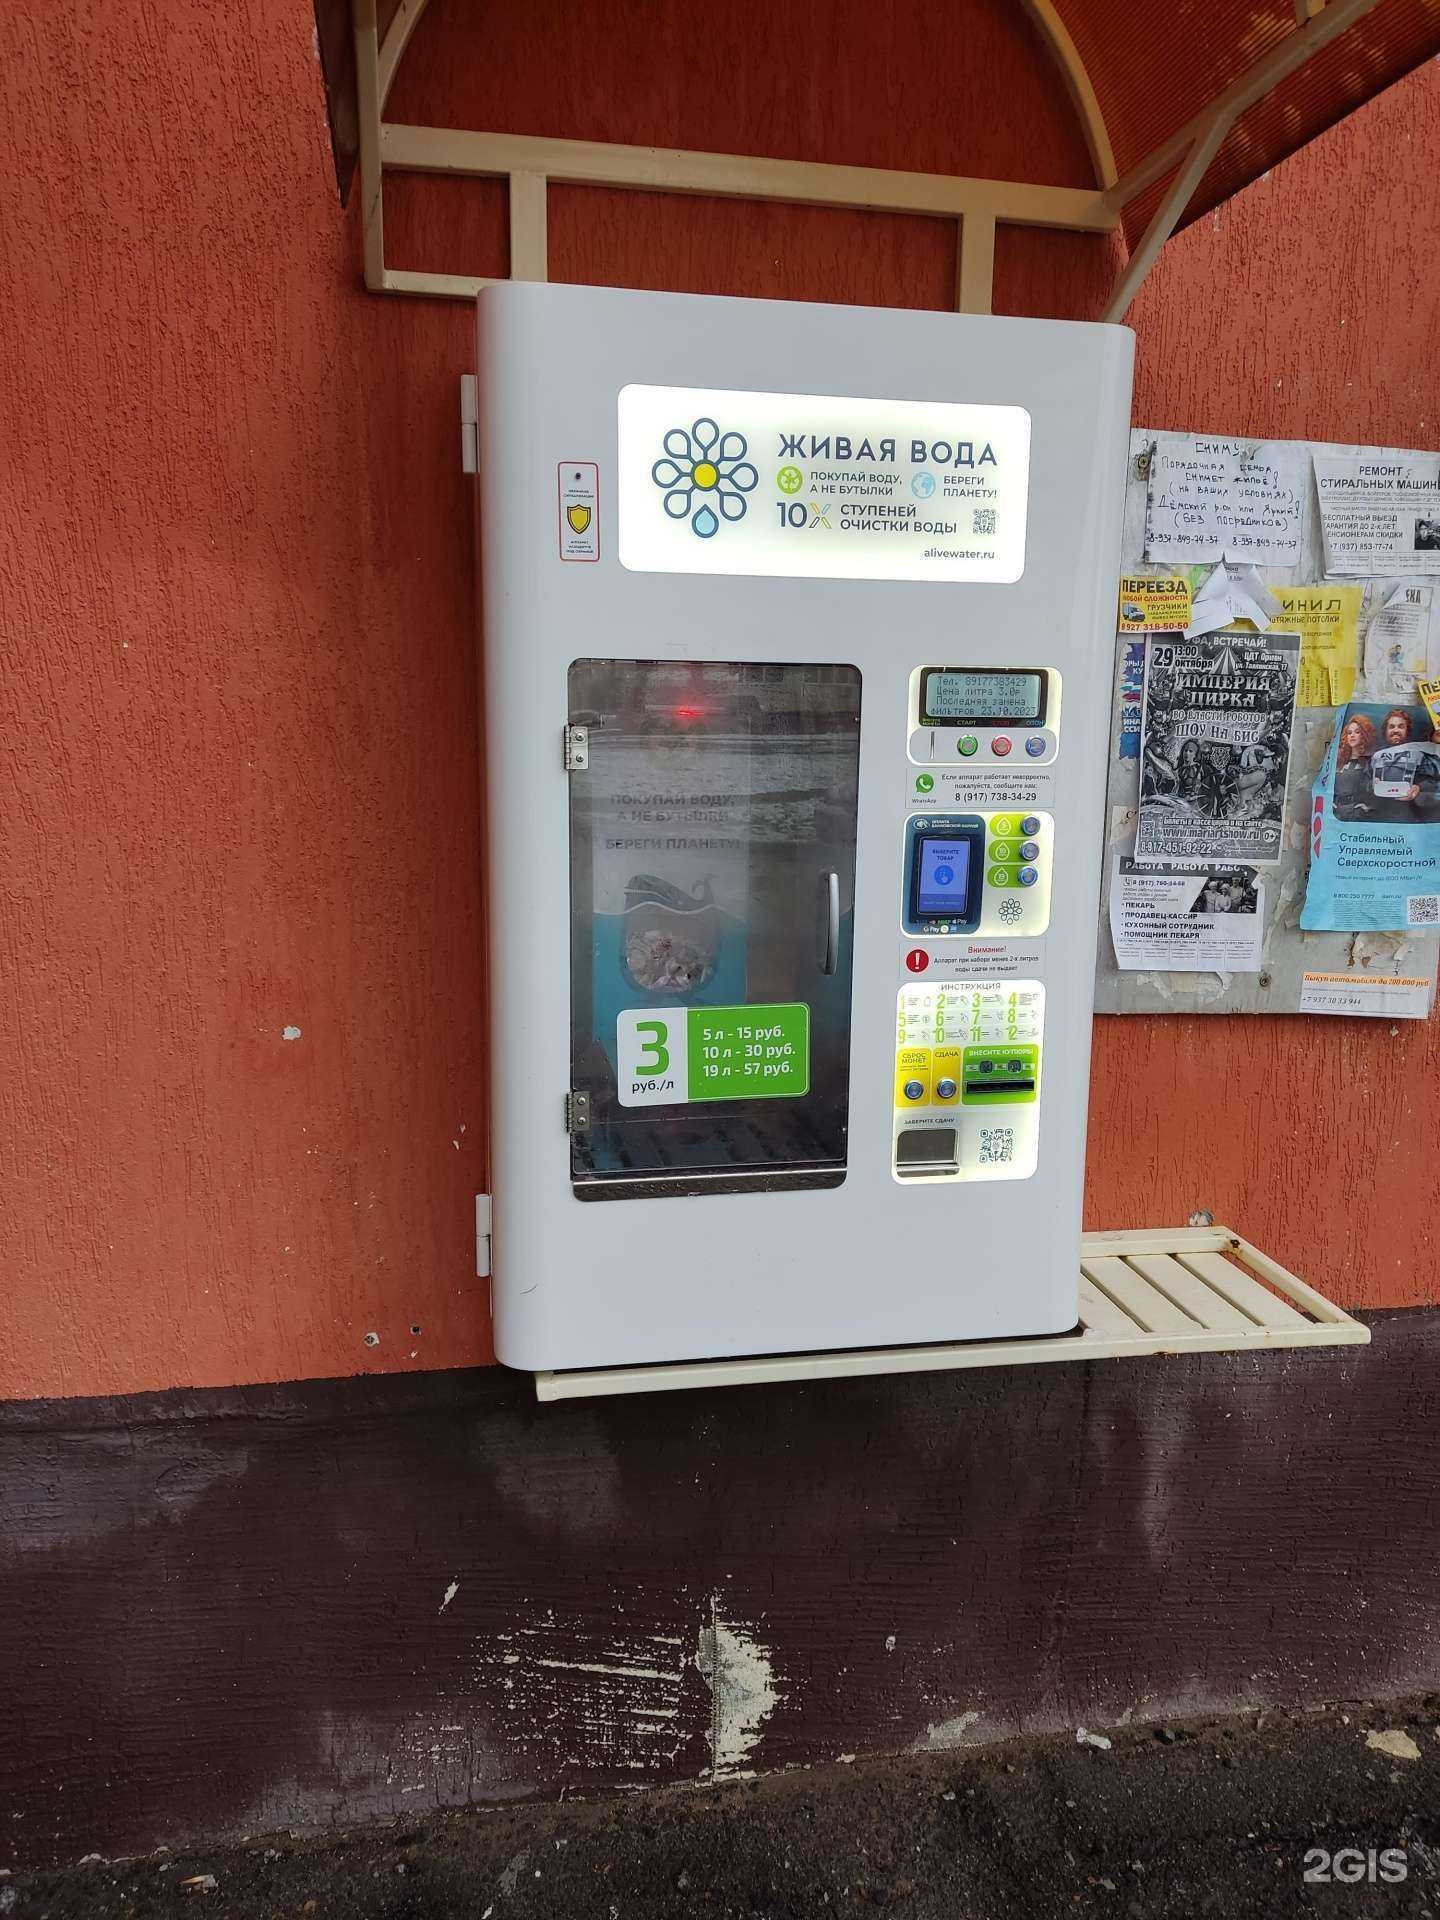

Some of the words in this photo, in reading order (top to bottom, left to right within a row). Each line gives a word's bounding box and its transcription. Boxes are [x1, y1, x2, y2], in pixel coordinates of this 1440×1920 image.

[777, 433, 896, 462] ЖИВАЯ
[910, 440, 998, 468] ВОДА
[1359, 465, 1403, 476] РЕМОНТ
[810, 471, 866, 484] ПОКУПАЙ
[869, 472, 904, 486] ВОДУ,
[943, 475, 985, 487] БЕРЕГИ
[1320, 479, 1394, 490] СТИРАЛЬНЫХ
[809, 485, 818, 494] А
[821, 485, 836, 494] НЕ
[838, 486, 894, 496] БУТЫЛКИ
[943, 487, 998, 499] ПЛАНЕТУ!
[840, 503, 917, 518] СТУПЕНЕЙ
[840, 518, 908, 533] ОЧИСТКИ
[913, 520, 957, 535] ВОДЫ
[1339, 542, 1358, 552] (937)
[923, 548, 996, 560] alivewater.ru
[1122, 579, 1188, 594] ПЕРЕЕЗД
[1143, 594, 1188, 602] СЛОЖНОСТИ
[1282, 599, 1341, 611] ИНИЛ
[1306, 616, 1340, 624] ПОТОЛКИ
[1126, 623, 1140, 631] 927
[1213, 637, 1267, 648] ВСТРЕЧАЙ!
[1154, 647, 1174, 667] 29
[1173, 646, 1198, 657] 13:00
[1174, 658, 1214, 670] октября
[936, 676, 958, 686] Тел.
[1176, 673, 1271, 690] ИМПЕРИЯ
[936, 686, 960, 697] Цена
[965, 688, 993, 697] литра
[936, 696, 988, 706] Последняя
[1188, 690, 1256, 708] ЦИРКА
[1173, 710, 1186, 720] ВО
[1175, 724, 1206, 737] ШОУ
[1210, 726, 1228, 739] НА
[1234, 730, 1260, 743] БИС
[610, 794, 686, 806] ПОКУПАЙ
[690, 794, 735, 808] ВОДУ,
[955, 792, 961, 801] 8
[964, 792, 988, 803] (917)
[991, 792, 1037, 801] 738-34-29
[617, 812, 626, 821] А
[632, 812, 651, 822] НЕ
[656, 811, 728, 823] БУТЫЛКИ
[606, 839, 660, 850] БЕРЕГИ
[666, 838, 740, 850] ПЛАНЕТУ!
[1340, 832, 1404, 844] Стабильный
[1338, 845, 1413, 857] Управляемый
[1337, 858, 1436, 870] Сверхскоростной
[1124, 912, 1198, 920] ПРОДАВЕЦ-КАССИР
[1124, 921, 1167, 929] КУХОННЫЙ
[1124, 932, 1168, 940] ПОМОЩНИК
[968, 946, 1007, 954] Внимание!
[941, 982, 1001, 992] ИНСТРУКЦИЯ
[937, 994, 946, 1009] 2
[972, 992, 980, 1008] 3
[1008, 992, 1017, 1008] 4
[1312, 996, 1325, 1004] 937
[898, 1012, 906, 1028] 5
[936, 1011, 944, 1026] 6
[972, 1010, 980, 1025] 7
[1008, 1008, 1016, 1024] 8
[703, 1028, 712, 1041] 5
[714, 1030, 724, 1040] л
[736, 1026, 752, 1039] 15
[754, 1025, 784, 1042] руб.
[898, 1028, 906, 1044] 9
[932, 1028, 945, 1044] 10
[970, 1026, 981, 1042] 11
[635, 1020, 670, 1077] 3
[703, 1046, 720, 1059] 10
[722, 1048, 732, 1058] л
[744, 1044, 762, 1058] 30
[766, 1042, 796, 1060] руб.
[935, 1050, 960, 1058] СДАЧА
[703, 1064, 718, 1078] 19
[721, 1066, 731, 1076] л
[744, 1062, 760, 1076] 57
[763, 1060, 794, 1078] руб.
[632, 1079, 674, 1095] руб./л
[904, 1118, 934, 1126] ЗАБЕРИТЕ
